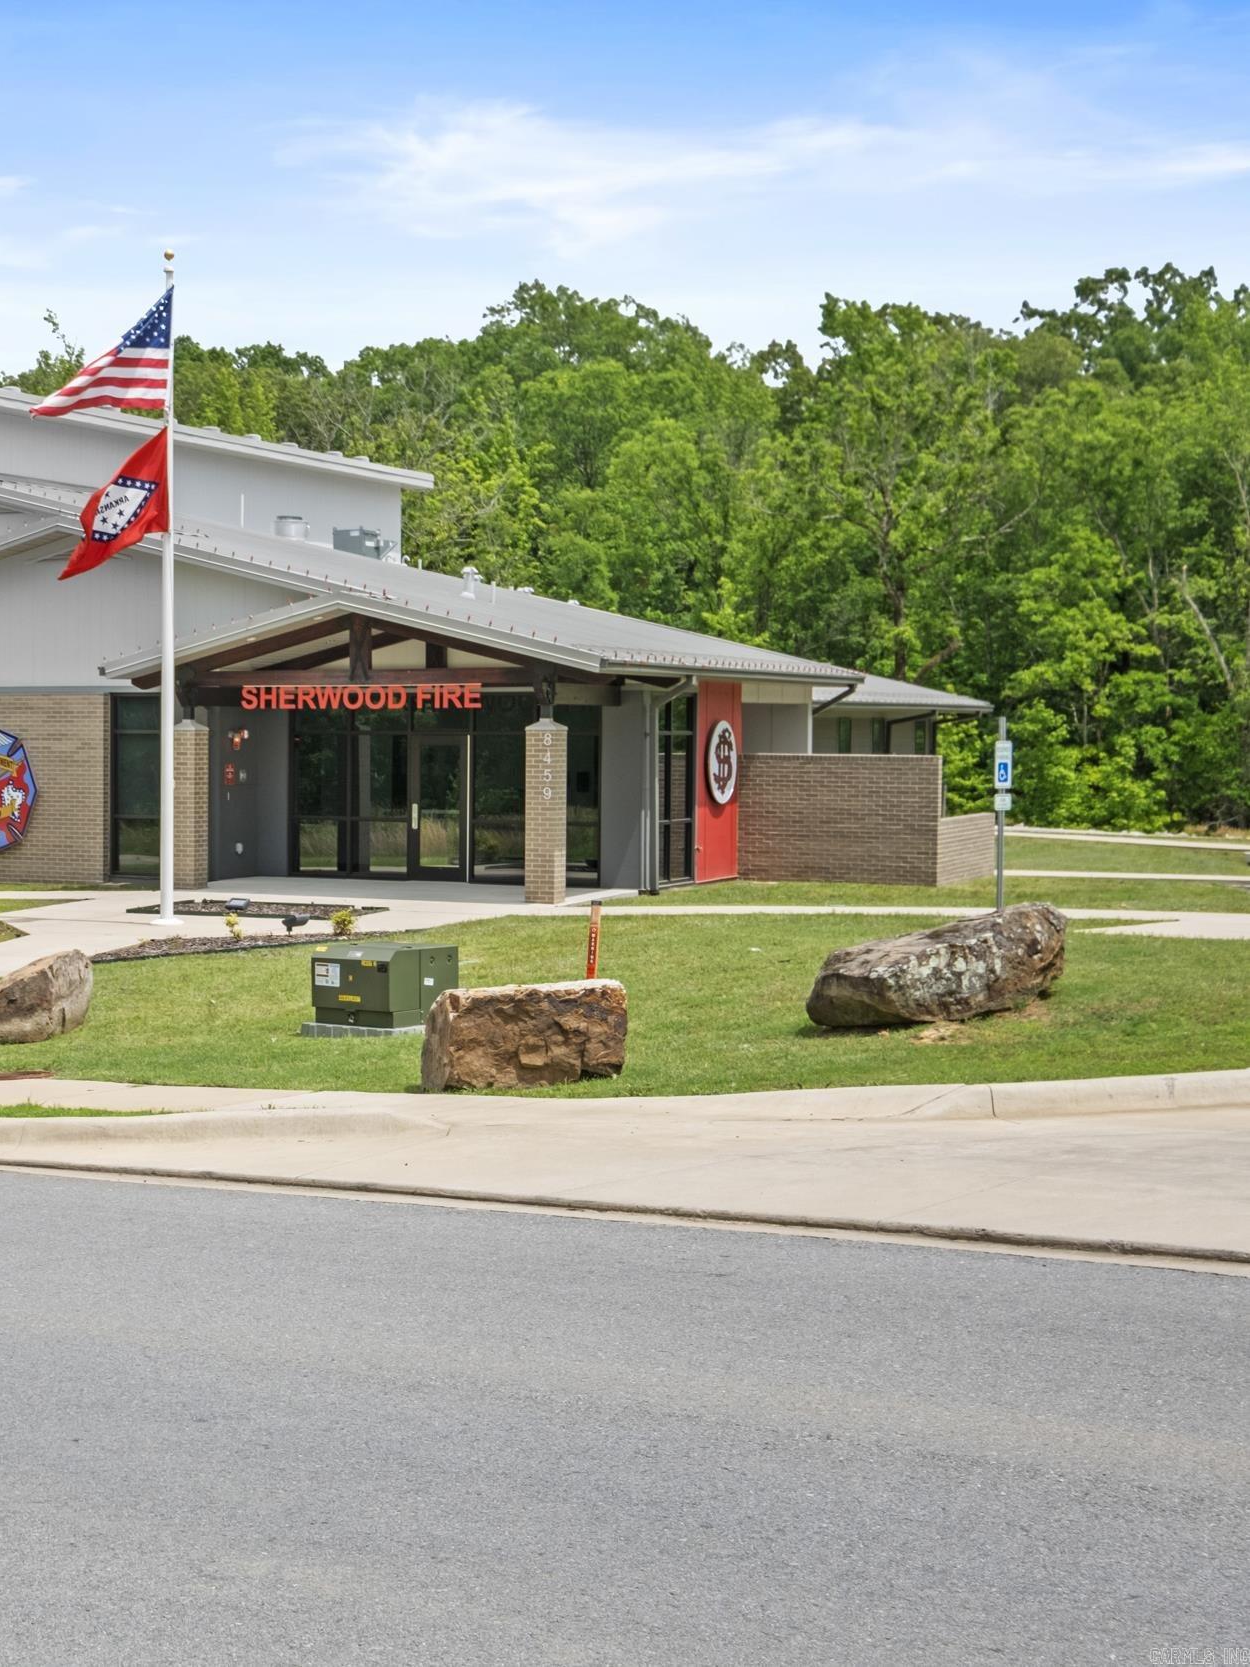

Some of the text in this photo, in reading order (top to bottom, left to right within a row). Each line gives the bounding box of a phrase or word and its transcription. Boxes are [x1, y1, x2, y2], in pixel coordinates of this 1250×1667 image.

[241, 685, 407, 711] SHERWOOD
[417, 684, 482, 710] FIRE
[543, 733, 552, 800] 8459
